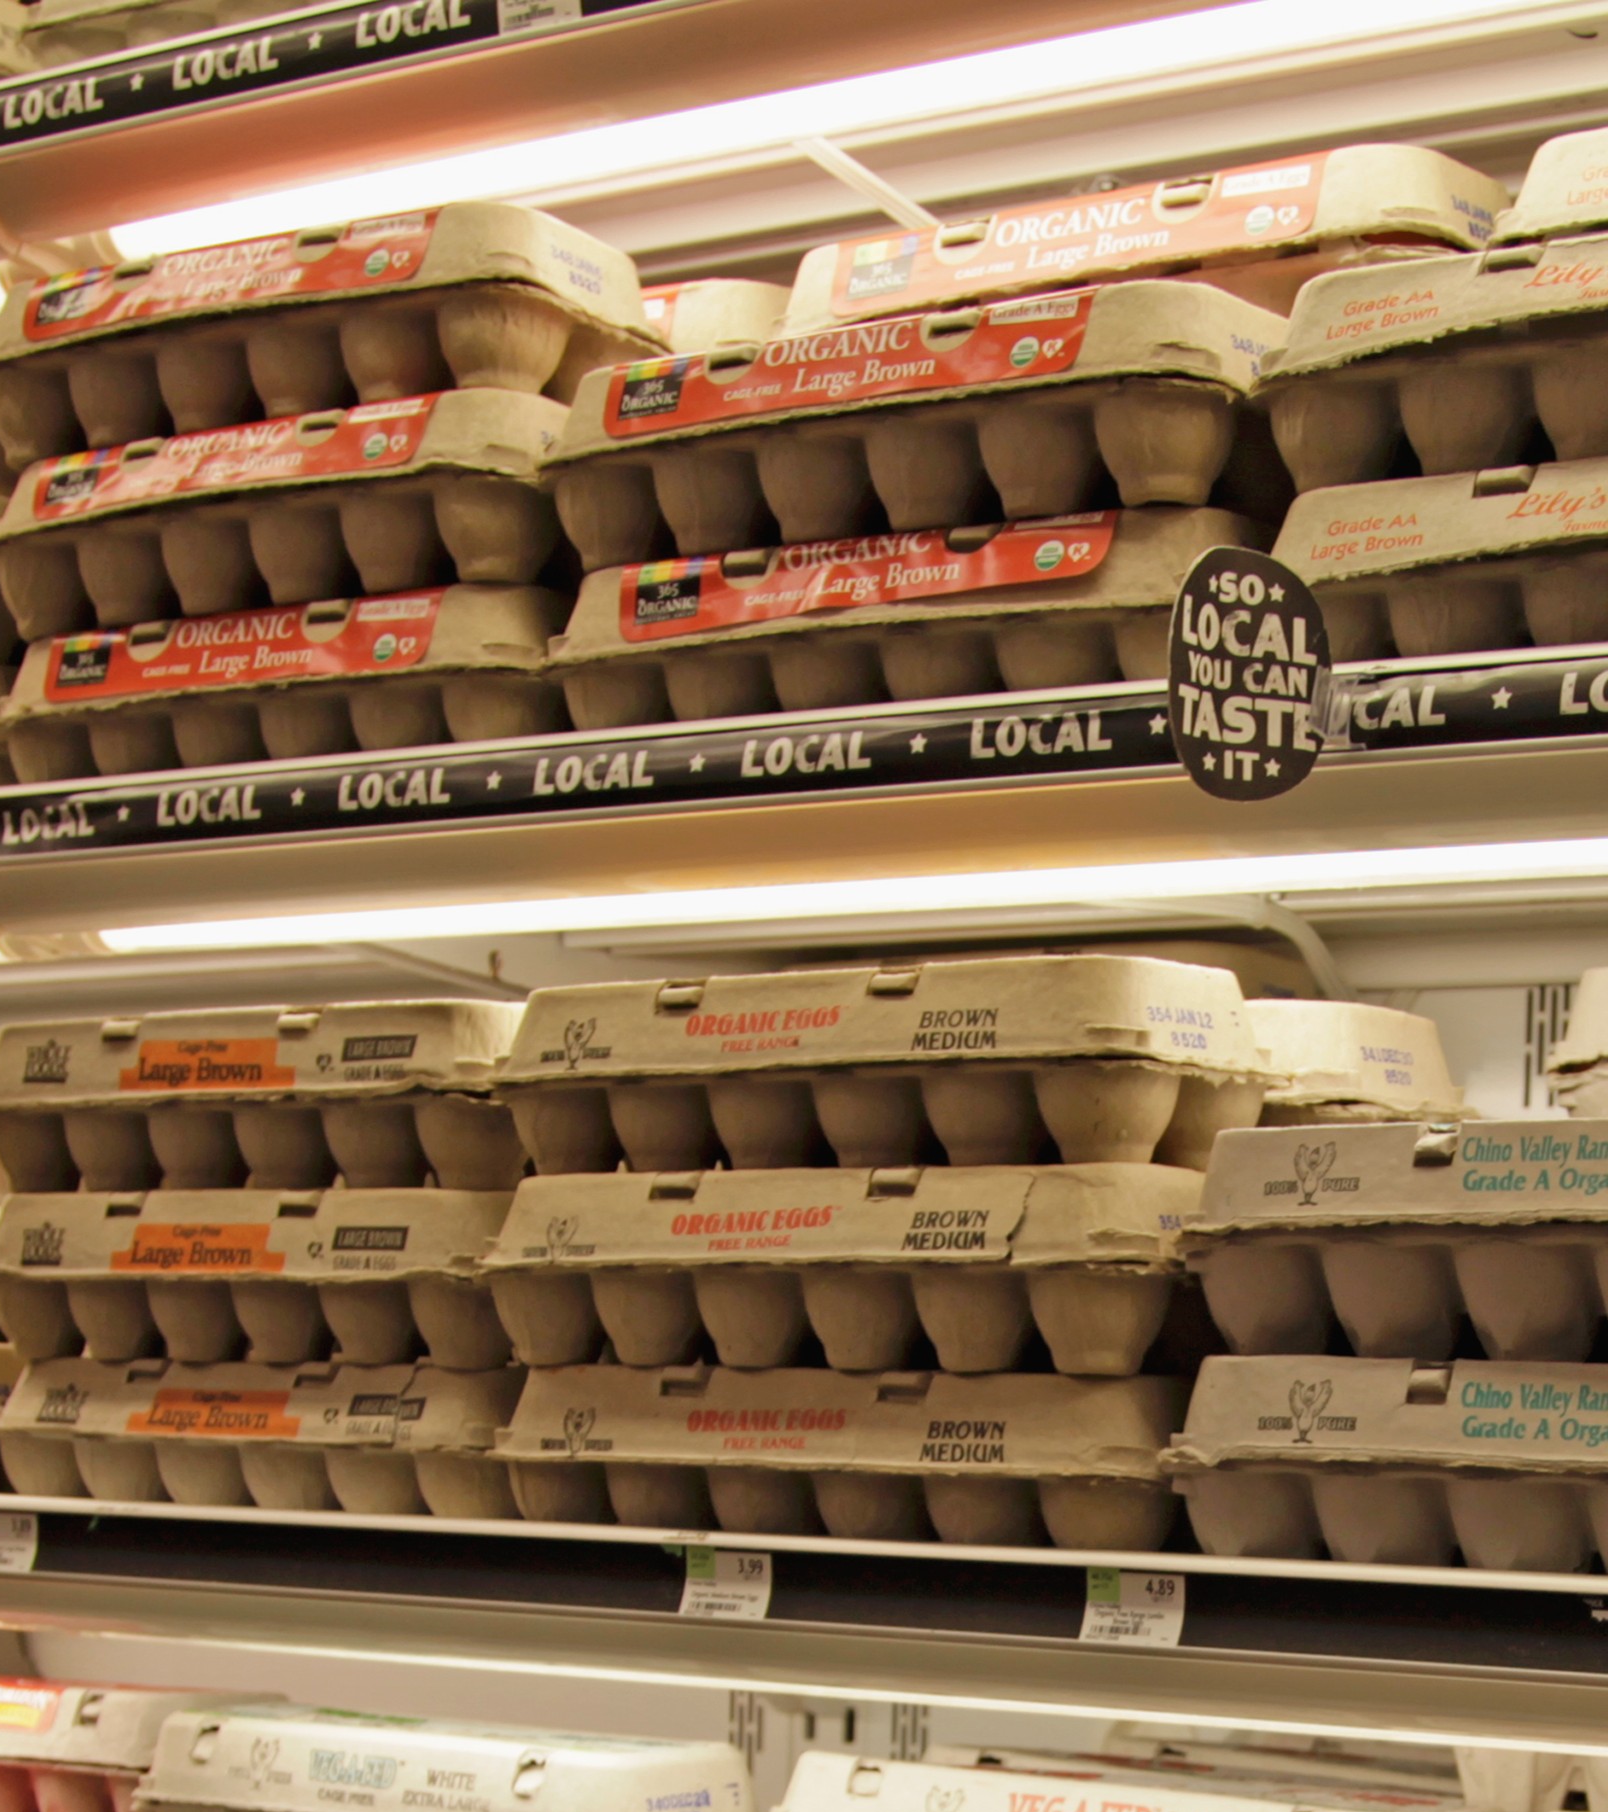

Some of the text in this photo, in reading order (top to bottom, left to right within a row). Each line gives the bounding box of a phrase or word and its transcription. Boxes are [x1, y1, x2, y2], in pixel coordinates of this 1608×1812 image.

[4, 0, 471, 129] LOCAL LOCAL LOCAL
[765, 322, 911, 366] ORGANIC
[642, 380, 666, 396] 365
[723, 355, 934, 401] CAGE-FREE Large Brown
[1219, 572, 1265, 603] SO
[1182, 594, 1318, 665] LOCAL
[1188, 651, 1308, 698] YOU CAN
[1178, 684, 1318, 753] TASTE
[2, 710, 1111, 844] LOCAL LOCAL LOCAL LOCAL LOCAL LOCAL
[1223, 751, 1259, 781] IT
[685, 1005, 841, 1037] ORGANIC EGGS
[918, 1009, 999, 1029] BROWN
[720, 1039, 754, 1052] FREE
[911, 1030, 998, 1050] MEDIUM
[138, 1057, 262, 1084] Large Brown
[737, 1557, 763, 1574] 3.99
[1146, 1579, 1175, 1597] 4.89
